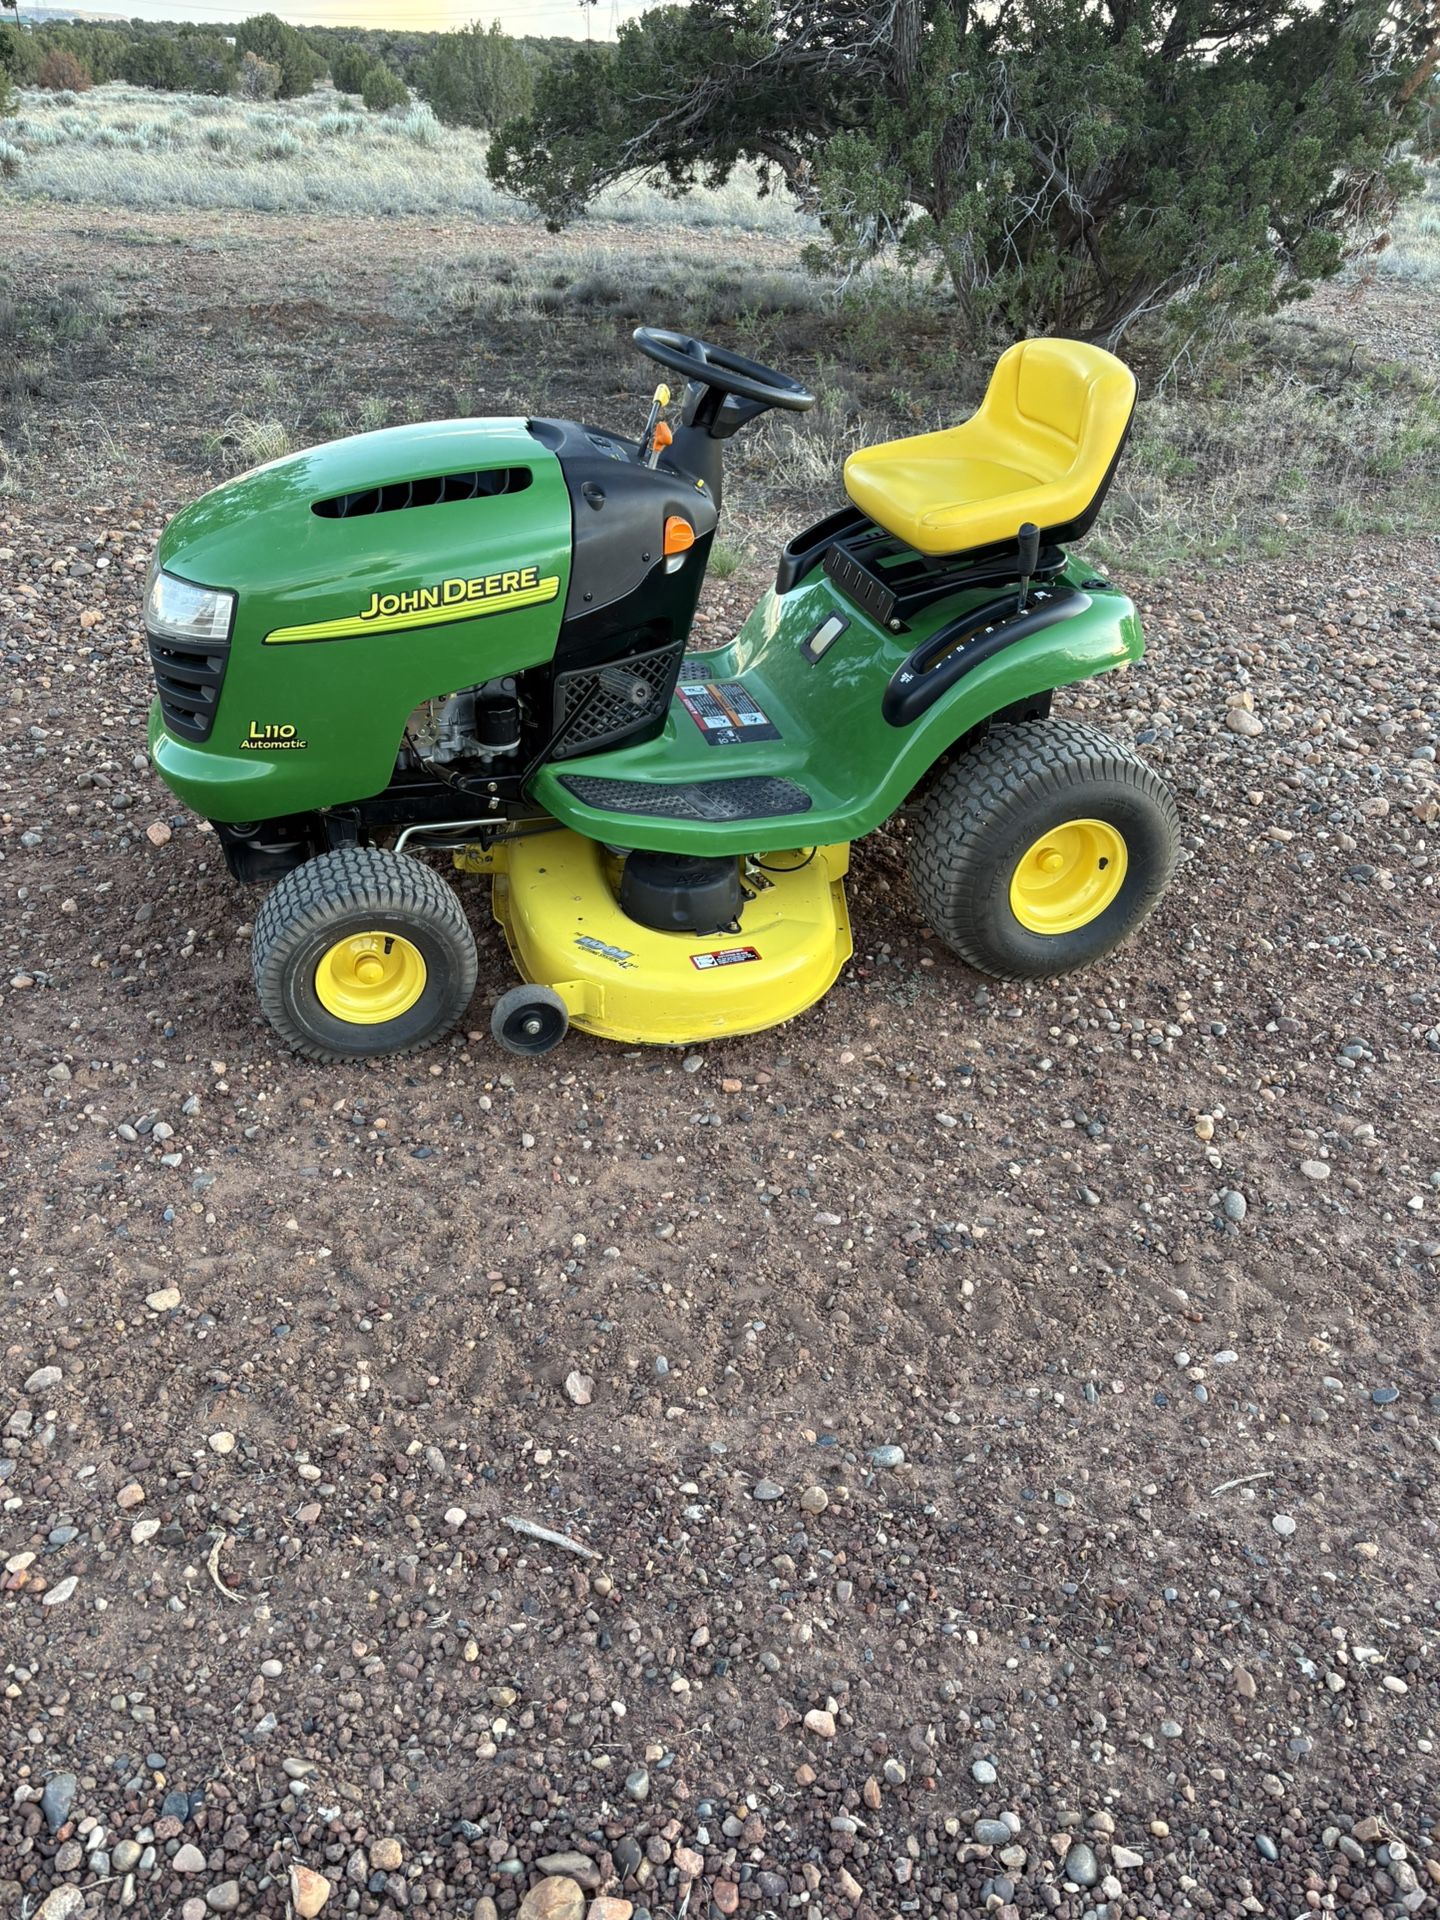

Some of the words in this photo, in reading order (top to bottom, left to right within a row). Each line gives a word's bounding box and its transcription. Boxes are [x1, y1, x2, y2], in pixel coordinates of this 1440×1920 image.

[360, 586, 440, 619] JOHN
[442, 565, 539, 604] DEERE
[249, 720, 297, 739] L110
[240, 739, 307, 750] Automatic
